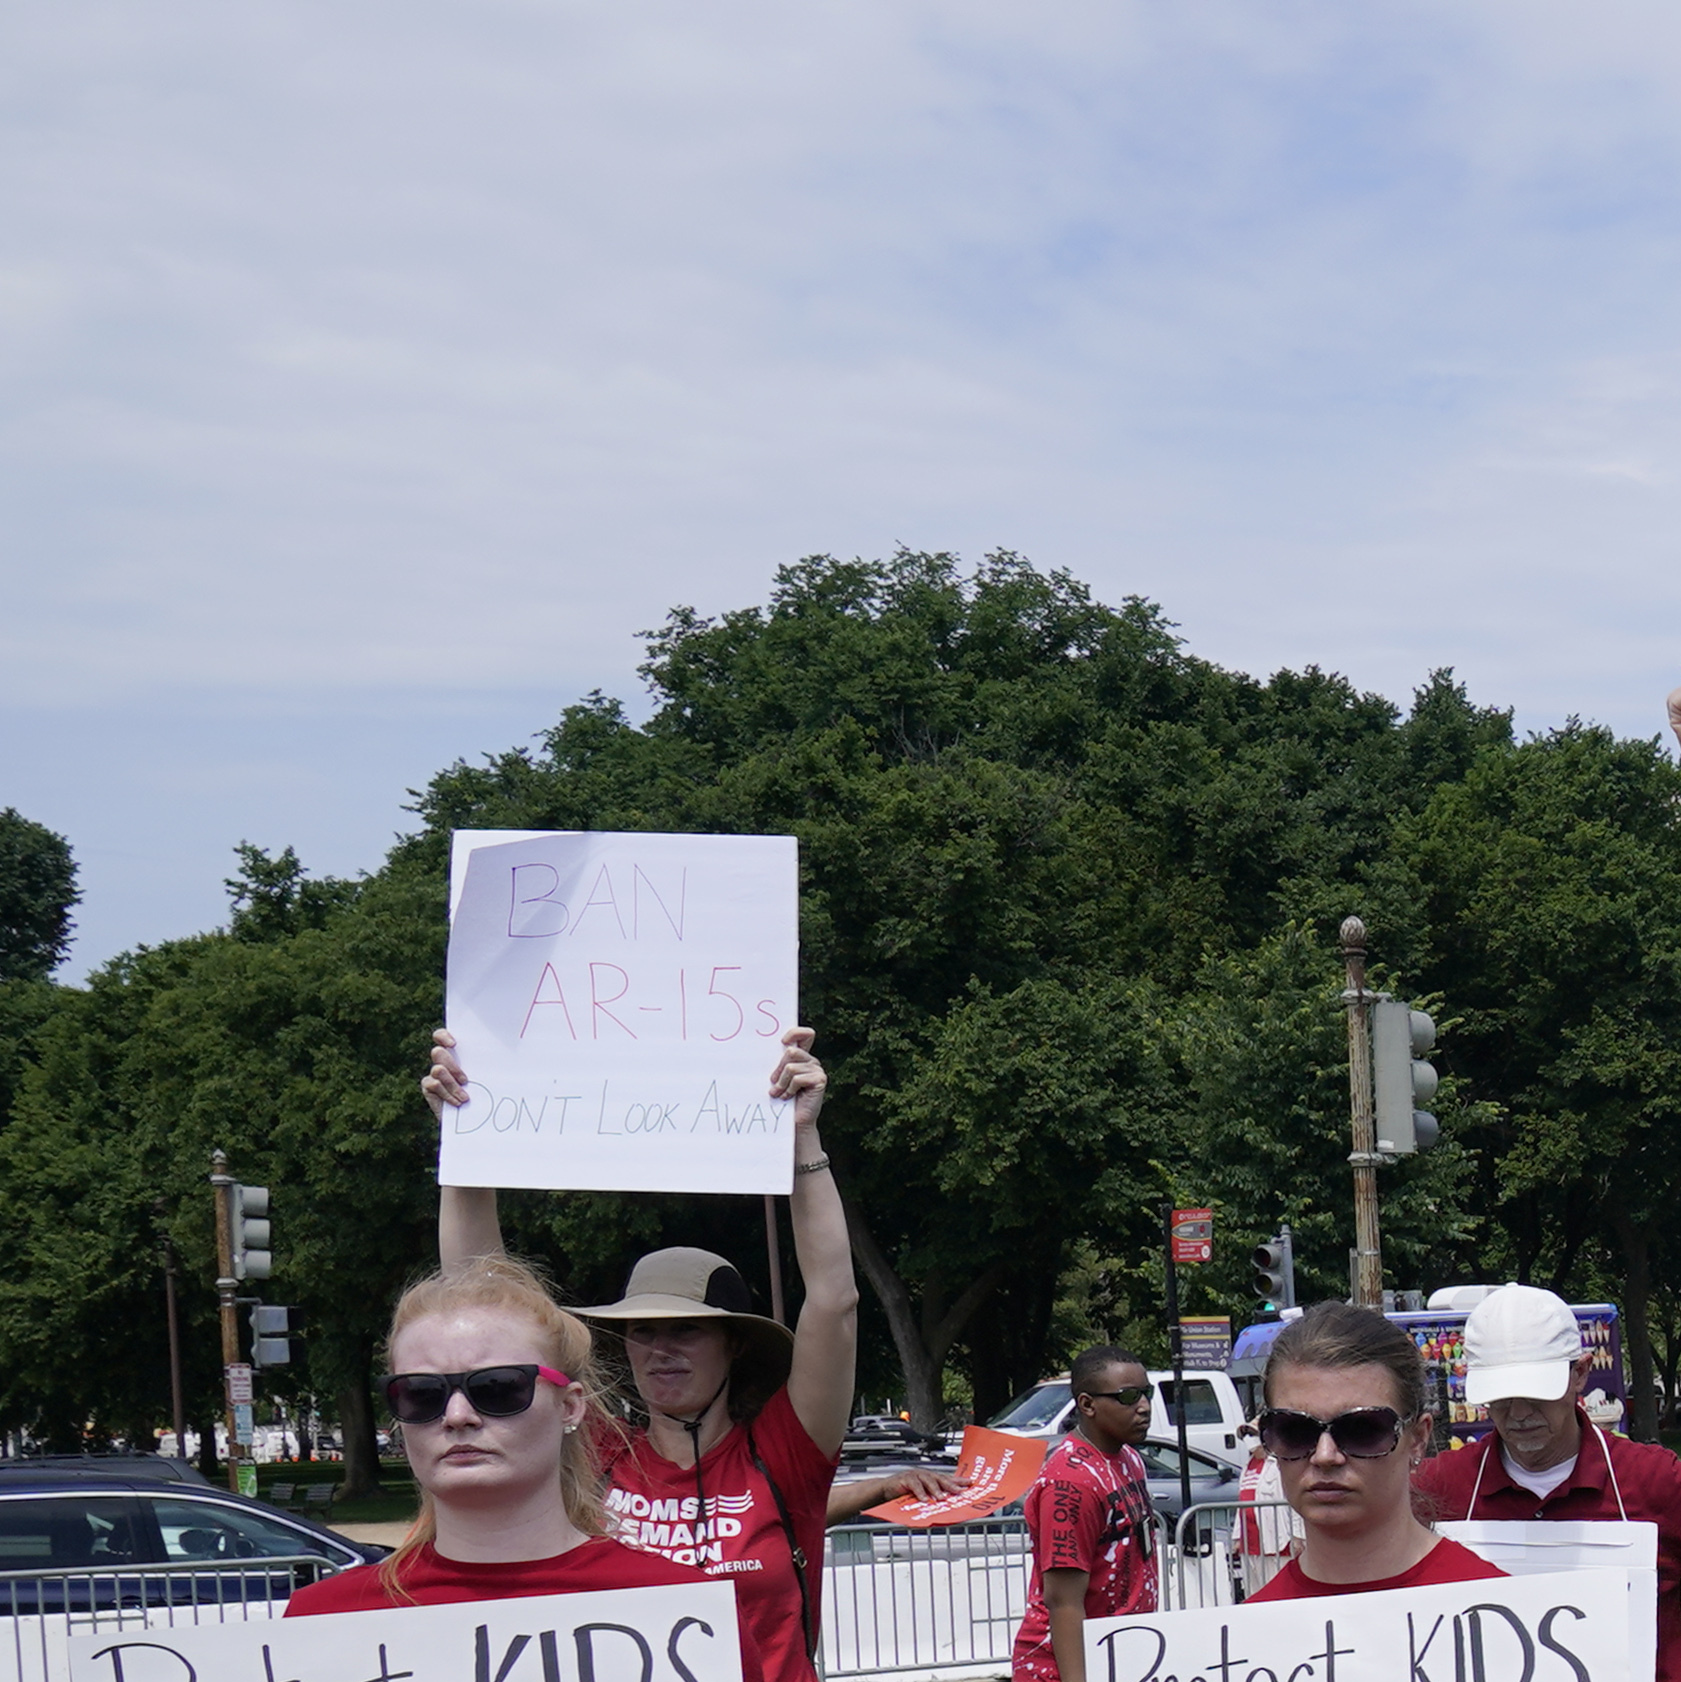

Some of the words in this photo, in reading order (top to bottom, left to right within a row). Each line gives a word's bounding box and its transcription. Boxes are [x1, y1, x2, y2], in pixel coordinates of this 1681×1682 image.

[508, 864, 686, 941] BAN
[520, 961, 779, 1041] AR-15s
[598, 1077, 679, 1133] LOOK
[691, 1080, 789, 1134] AWAY
[995, 1449, 1015, 1483] More
[604, 1488, 700, 1522] MOMS
[1053, 1479, 1071, 1524] ONE
[1052, 1529, 1069, 1568] THE
